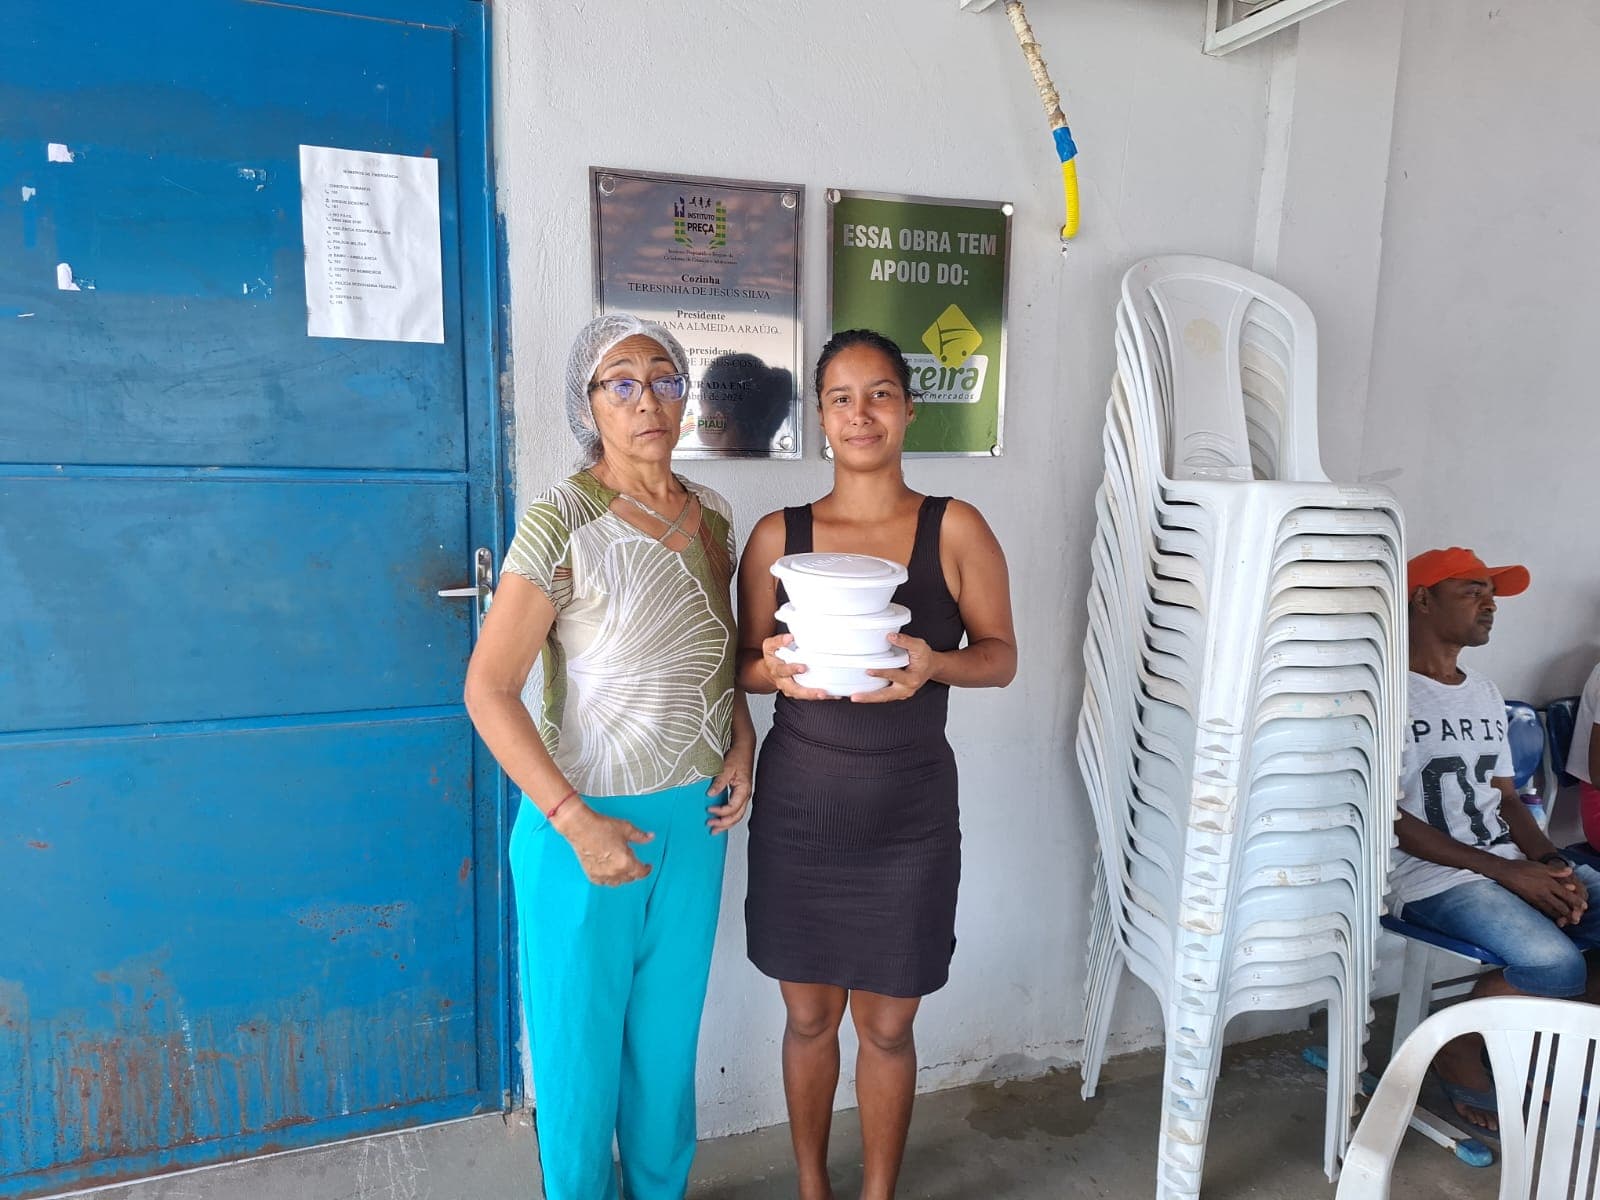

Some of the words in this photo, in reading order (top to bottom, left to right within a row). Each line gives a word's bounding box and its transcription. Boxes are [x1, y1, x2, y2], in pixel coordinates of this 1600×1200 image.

[687, 212, 715, 221] INSTITUTO
[687, 222, 715, 235] PREÇA
[843, 223, 892, 250] ESSA
[899, 227, 951, 253] OBRA
[957, 232, 997, 256] TEM
[681, 273, 721, 285] Cozinha
[870, 259, 930, 283] APOIO
[937, 263, 969, 286] DO:
[627, 281, 690, 296] TERESINHA
[692, 286, 706, 296] DE
[706, 287, 741, 298] JESUS
[742, 289, 771, 300] SILVA
[676, 309, 726, 321] Presidente
[686, 322, 736, 334] ALMEIDA
[683, 345, 737, 357] -presidente
[908, 366, 978, 391] reira
[1411, 718, 1505, 744] PARIS
